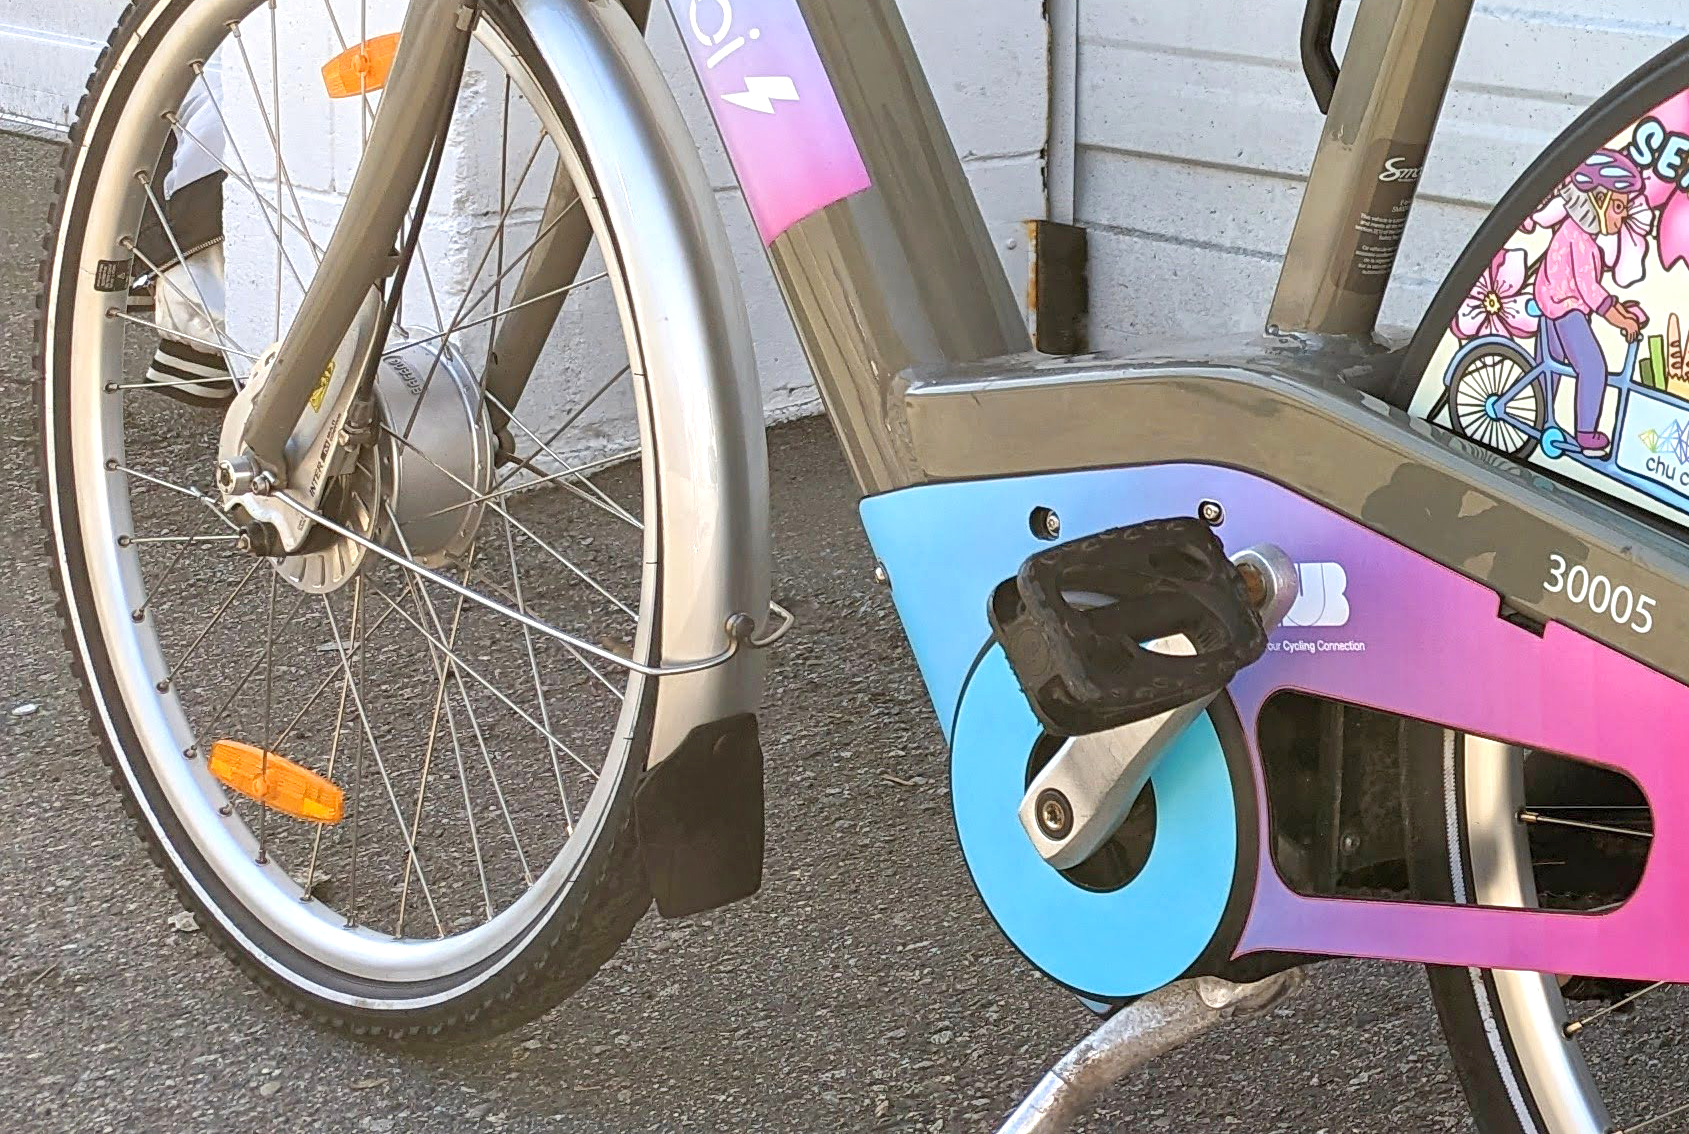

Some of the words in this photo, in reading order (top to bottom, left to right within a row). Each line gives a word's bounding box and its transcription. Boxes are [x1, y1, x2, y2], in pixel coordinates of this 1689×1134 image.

[309, 461, 324, 498] INTER
[1645, 456, 1677, 478] chu
[1277, 563, 1350, 627] UB
[1543, 554, 1657, 634] 30005
[1283, 640, 1316, 654] Cycling
[1316, 640, 1366, 652] Connection
